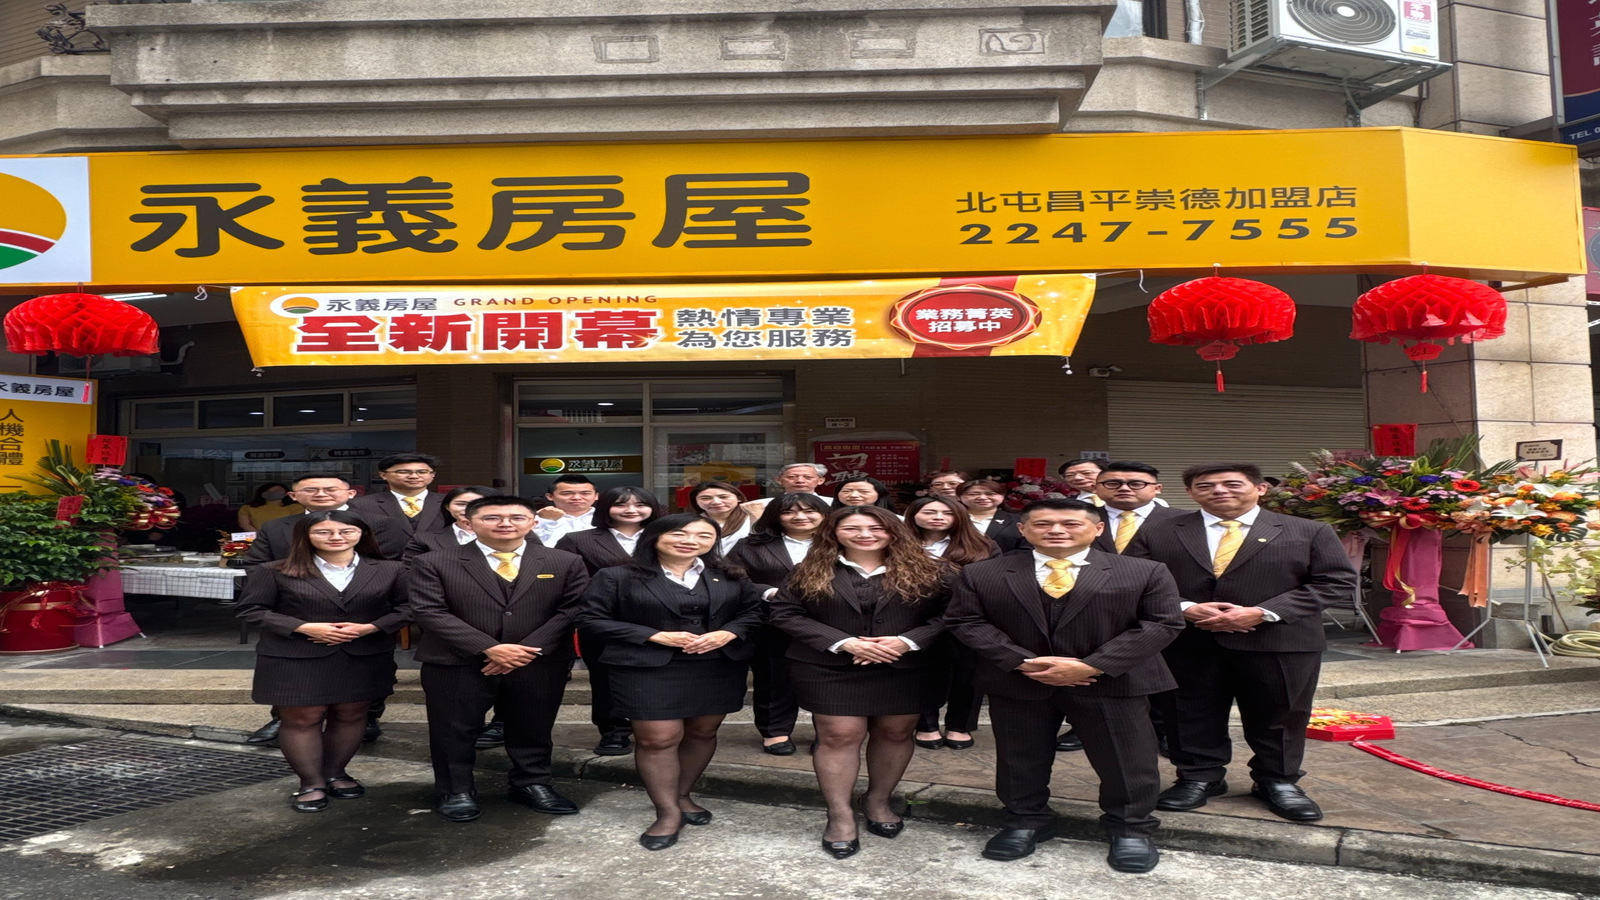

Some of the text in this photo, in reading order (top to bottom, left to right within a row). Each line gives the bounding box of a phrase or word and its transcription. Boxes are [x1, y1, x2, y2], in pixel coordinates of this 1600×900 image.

[1569, 130, 1592, 140] TEL
[956, 186, 1357, 214] 北屯昌平崇德加盟店
[129, 172, 812, 258] 永義房屋
[960, 217, 1358, 245] 2247-7555
[327, 297, 437, 312] 永義房屋
[454, 294, 657, 306] GRAND OPENING
[677, 307, 852, 327] 熱情專業
[915, 307, 1014, 321] 業務菁英
[296, 311, 658, 352] 全新開幕
[928, 320, 1002, 334] 招募中
[677, 328, 852, 349] 為您服務
